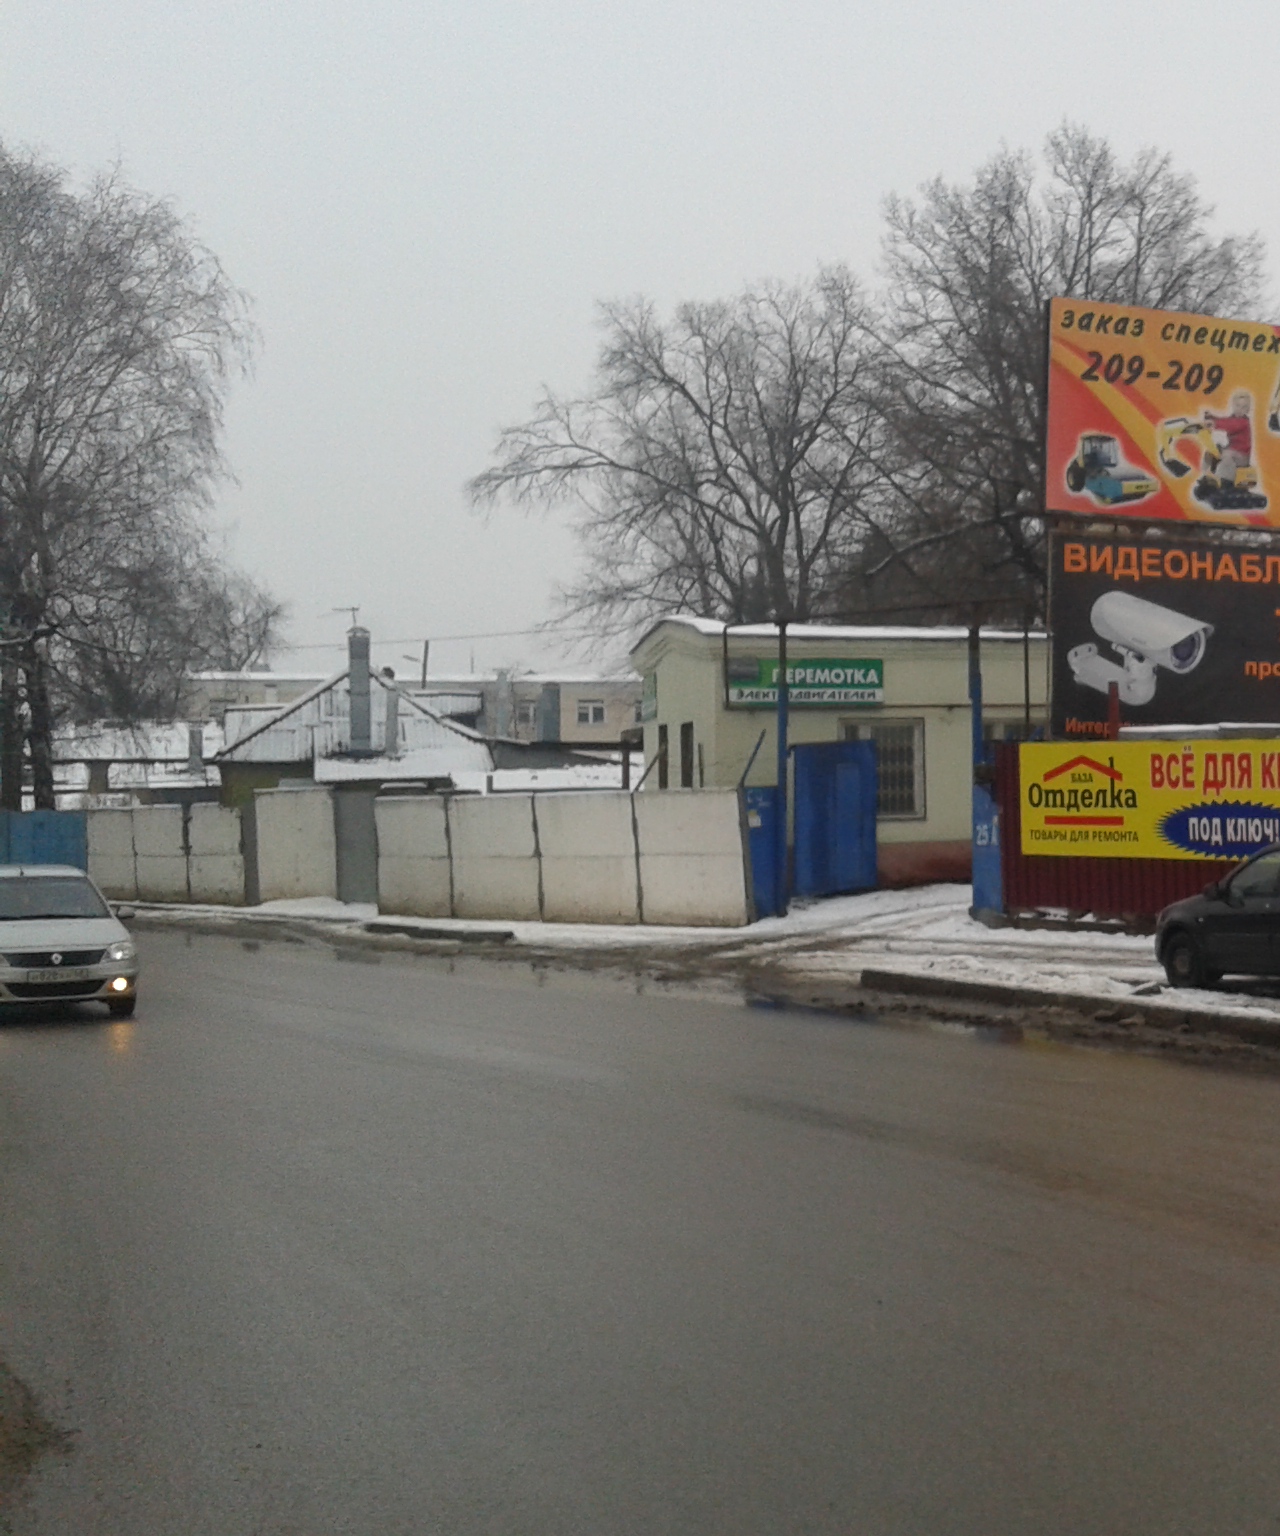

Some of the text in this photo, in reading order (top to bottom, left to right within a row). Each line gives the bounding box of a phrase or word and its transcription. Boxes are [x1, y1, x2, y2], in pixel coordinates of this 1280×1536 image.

[1060, 308, 1145, 337] заказ
[1080, 350, 1224, 395] 209-209
[737, 688, 876, 700] ЭЛЕКТОДВИГАТЕЛЕЙ
[1071, 773, 1093, 783] БАЗА
[1150, 745, 1195, 789] ВСЁ
[1202, 752, 1251, 796] ДЛЯ
[1028, 762, 1138, 812] Отделка
[1030, 830, 1139, 842] ТОВАРЫ ДЛЯ РЕМОНТА
[1188, 817, 1280, 846] ПОД КЛЮЧ!
